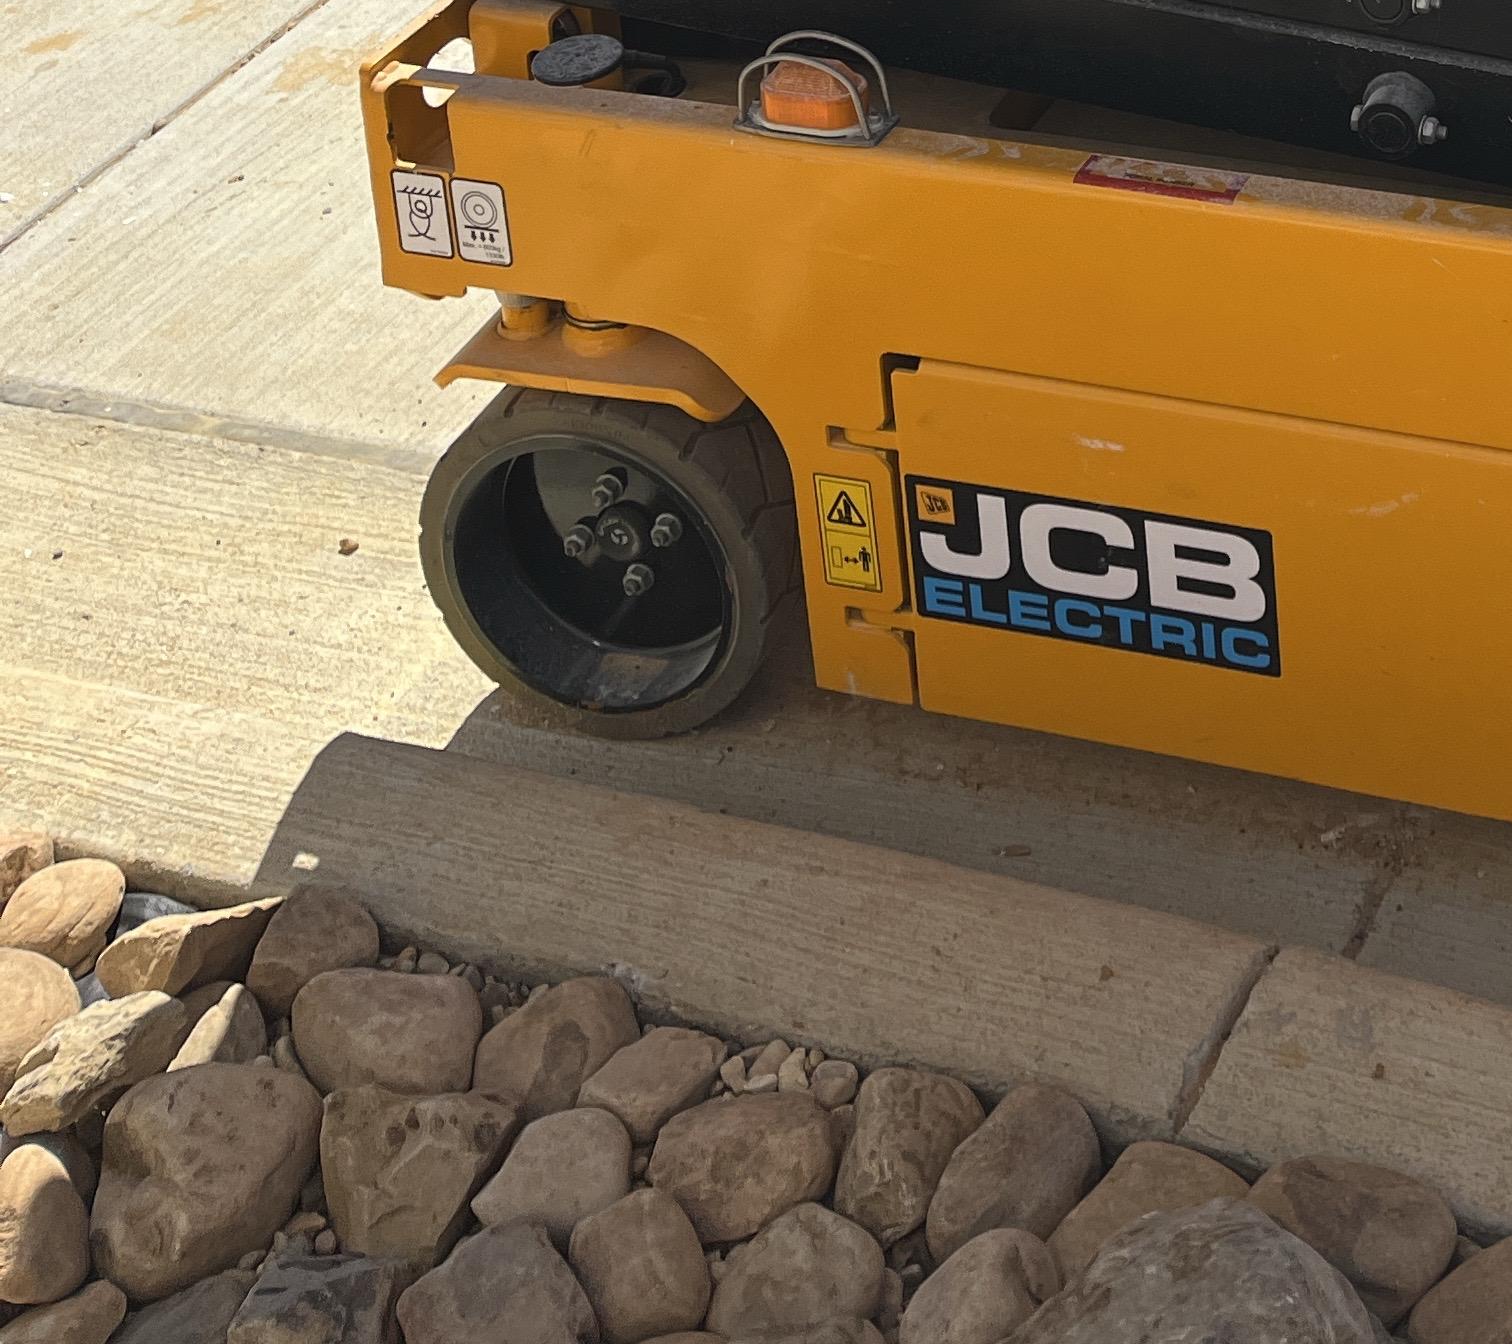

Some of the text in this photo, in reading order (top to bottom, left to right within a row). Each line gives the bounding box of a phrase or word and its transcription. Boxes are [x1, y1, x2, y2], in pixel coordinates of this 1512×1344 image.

[926, 492, 950, 513] JCB
[920, 493, 1266, 622] JCB
[923, 576, 1271, 668] ELECTRIC
